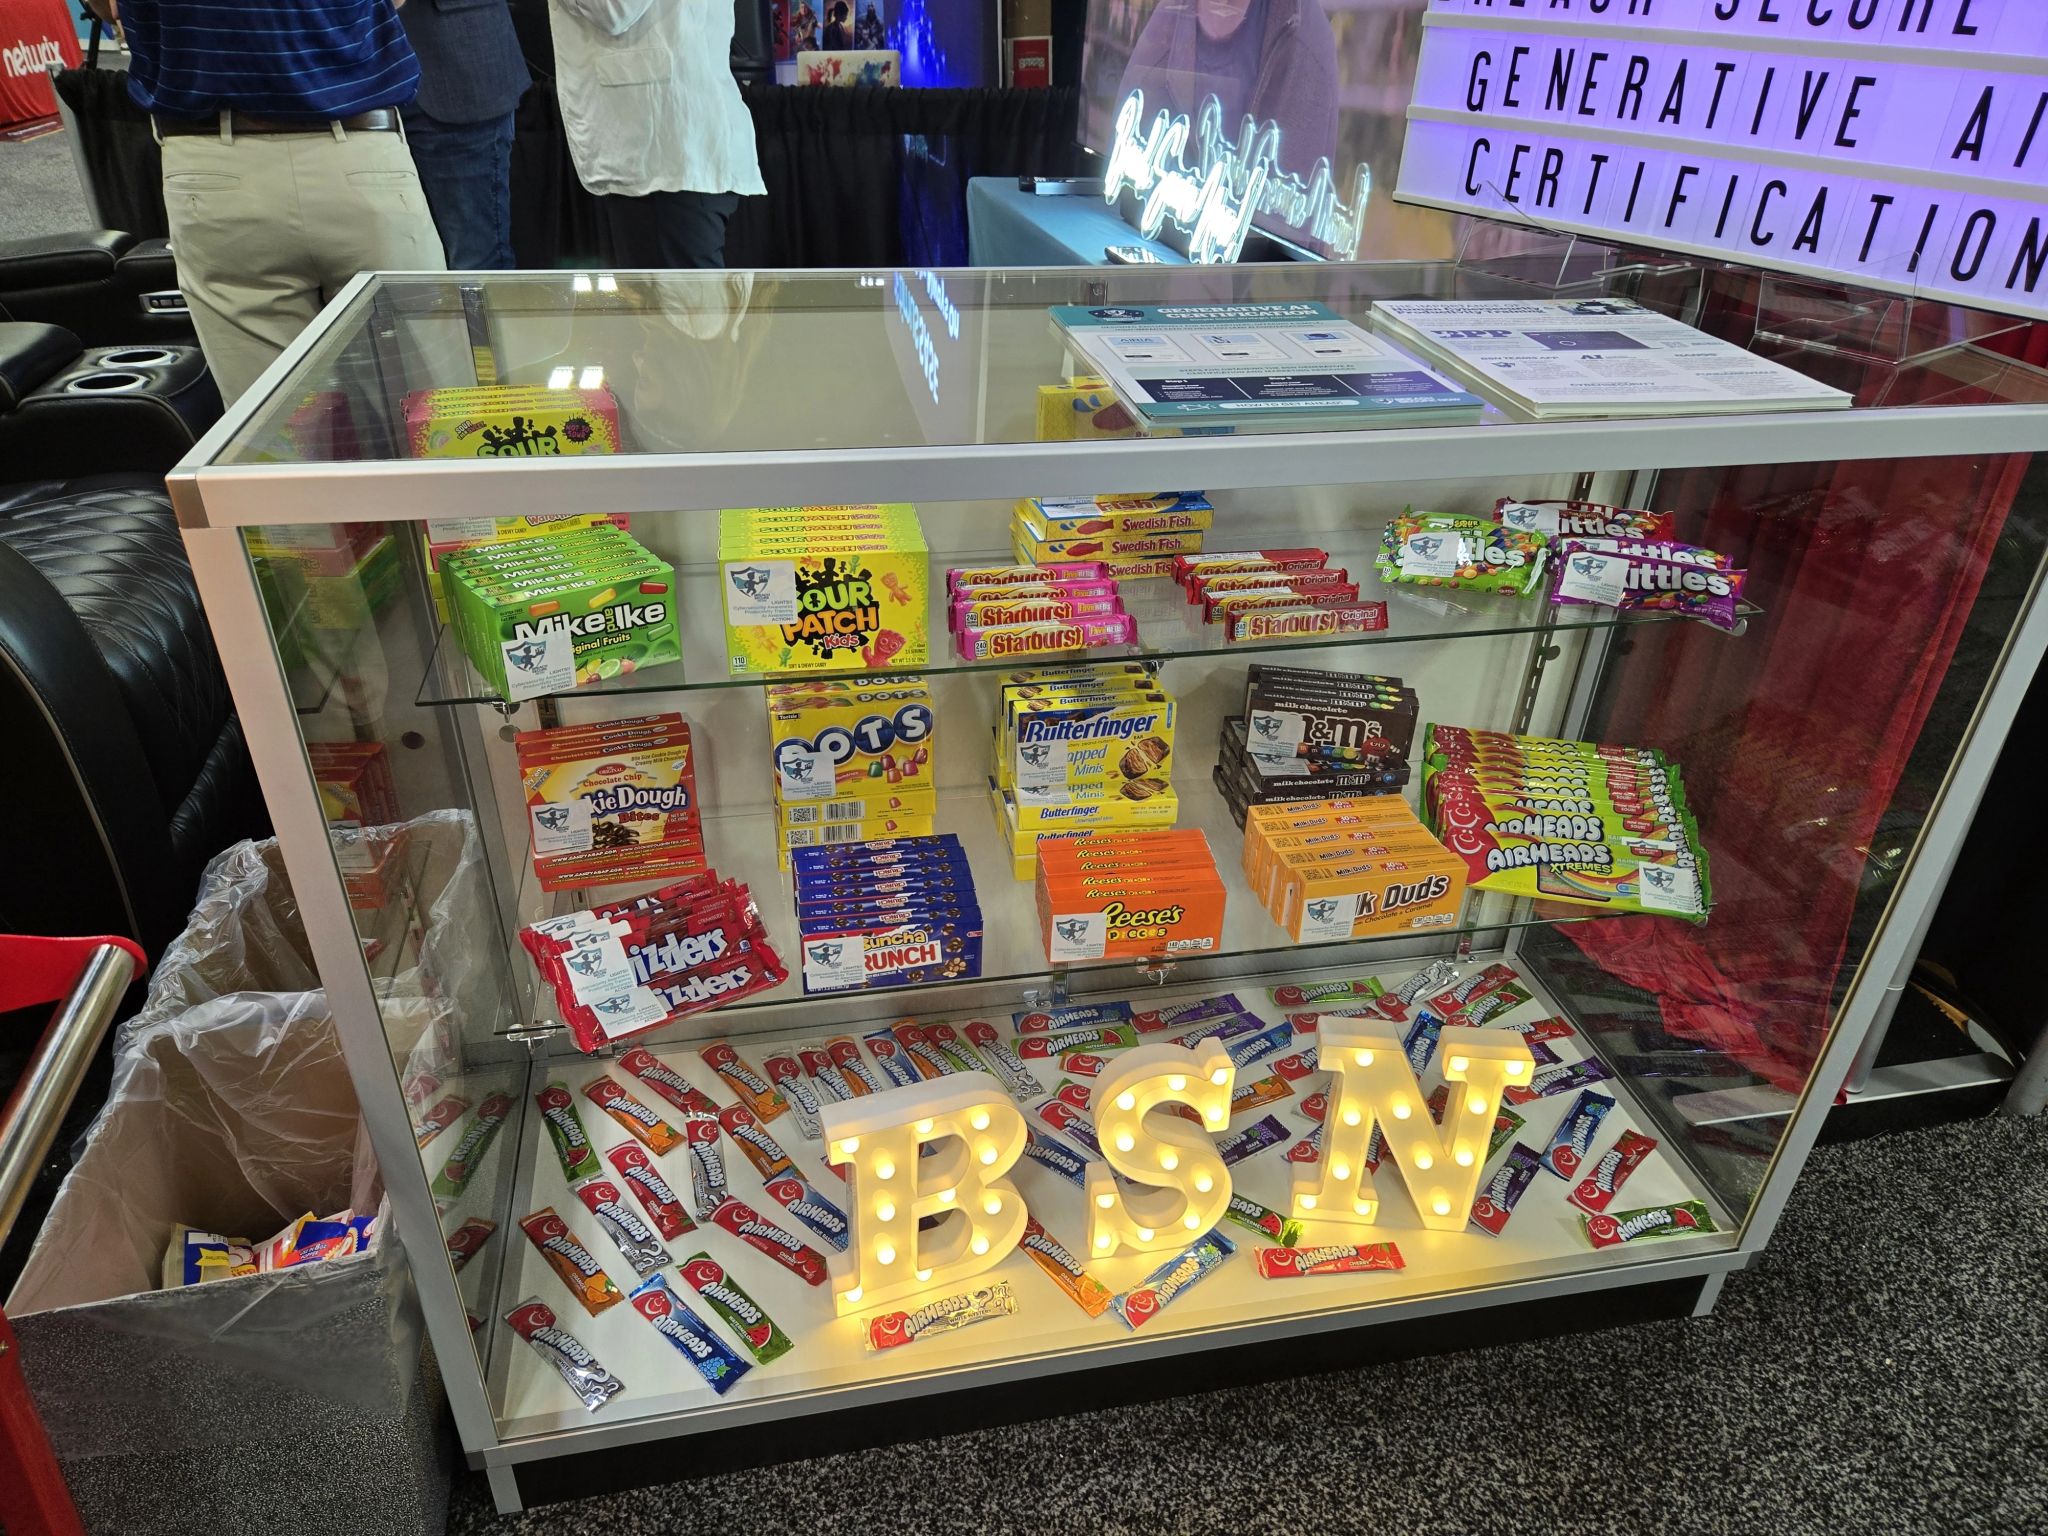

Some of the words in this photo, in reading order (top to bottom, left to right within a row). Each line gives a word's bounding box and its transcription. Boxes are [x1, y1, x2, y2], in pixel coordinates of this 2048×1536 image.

[1466, 47, 1877, 147] GENERATIVE
[1951, 86, 2048, 168] AI
[1465, 138, 2048, 293] CERTIFICATION
[1157, 305, 1285, 314] GENERATIVE
[1166, 310, 1319, 319] CERTIFICATION
[1122, 518, 1167, 532] Swedish
[1169, 515, 1191, 528] Fish
[1112, 541, 1156, 553] Swedish
[1159, 538, 1181, 549] Fish
[1109, 564, 1152, 576] Swedish
[1155, 563, 1172, 573] Fis
[1287, 561, 1320, 570] Original
[1304, 575, 1338, 585] Original
[1317, 594, 1351, 604] Original
[514, 613, 600, 641] Mike
[614, 602, 667, 631] Ike
[781, 607, 878, 641] PATCH
[983, 603, 1071, 626] Starburst
[1251, 612, 1337, 636] Starburst
[1342, 610, 1377, 620] Original
[602, 634, 631, 645] Fruits
[824, 633, 859, 650] Kids
[975, 641, 987, 649] 240
[992, 630, 1082, 653] Starburst
[856, 689, 926, 702] DOTS
[1050, 681, 1104, 691] Butterfinger
[1060, 694, 1116, 705] Butterfinger
[1300, 704, 1348, 713] chocolate
[1026, 713, 1158, 743] Butterfinger
[583, 776, 622, 788] Chocolate
[624, 773, 642, 783] Chip
[1074, 763, 1104, 776] Minis
[617, 786, 686, 811] Dough
[1041, 805, 1099, 819] Butterfinger
[618, 811, 661, 824] Bites
[1293, 819, 1308, 828] Milk
[1309, 817, 1327, 826] Duds
[1304, 835, 1320, 844] Milk
[1321, 832, 1340, 842] Duds
[1319, 851, 1335, 860] Milk
[1336, 848, 1355, 858] Duds
[1486, 842, 1612, 872] AIRHEADS
[1550, 862, 1612, 874] XTREMES
[1336, 867, 1352, 877] Milk
[1353, 864, 1372, 874] Duds
[1383, 875, 1449, 911] Duds
[1103, 902, 1185, 929] Reese's
[865, 943, 937, 972] RUNCH
[1301, 982, 1350, 1002] AIRHEADS
[1453, 972, 1485, 1003] AIRHEADS
[1048, 1008, 1099, 1031] AIRHEADS
[1159, 999, 1206, 1023] AIRHEADS
[1470, 996, 1501, 1027] AIRHEADS
[939, 1040, 987, 1072] AIRHEADS
[980, 1039, 1025, 1073] AIRHEADS
[1047, 1030, 1099, 1056] AIRHEADS
[639, 1066, 693, 1095] AIRHEADS
[719, 1061, 769, 1096] AIRHEADS
[1530, 1066, 1573, 1096] AIRHEADS
[779, 1075, 820, 1113] AIRHEADS
[606, 1096, 659, 1128] AIRHEADS
[546, 1107, 586, 1147] AIRHEADS
[1572, 1114, 1594, 1158] AIRHEADS
[733, 1123, 786, 1164] AIRHEADS
[692, 1139, 726, 1188] AIRHEADS
[1595, 1150, 1624, 1192] AIRHEADS
[625, 1166, 677, 1204] AIRHEADS
[1490, 1165, 1515, 1212] AIRHEADS
[598, 1201, 650, 1242] AIRHEADS
[786, 1199, 846, 1233] AIRHEADS
[1616, 1209, 1672, 1242] AIRHEADS
[739, 1220, 802, 1251] AIRHEADS
[543, 1236, 600, 1276] AIRHEADS
[1026, 1233, 1086, 1277] AIRHEADS
[1295, 1245, 1358, 1272] AIRHEADS
[1155, 1256, 1199, 1309] AIRHEADS
[700, 1282, 762, 1325] AIRHEADS
[904, 1295, 971, 1337] AIRHEADS
[532, 1326, 594, 1366] AIRHEADS
[652, 1314, 713, 1359] AIRHEADS
